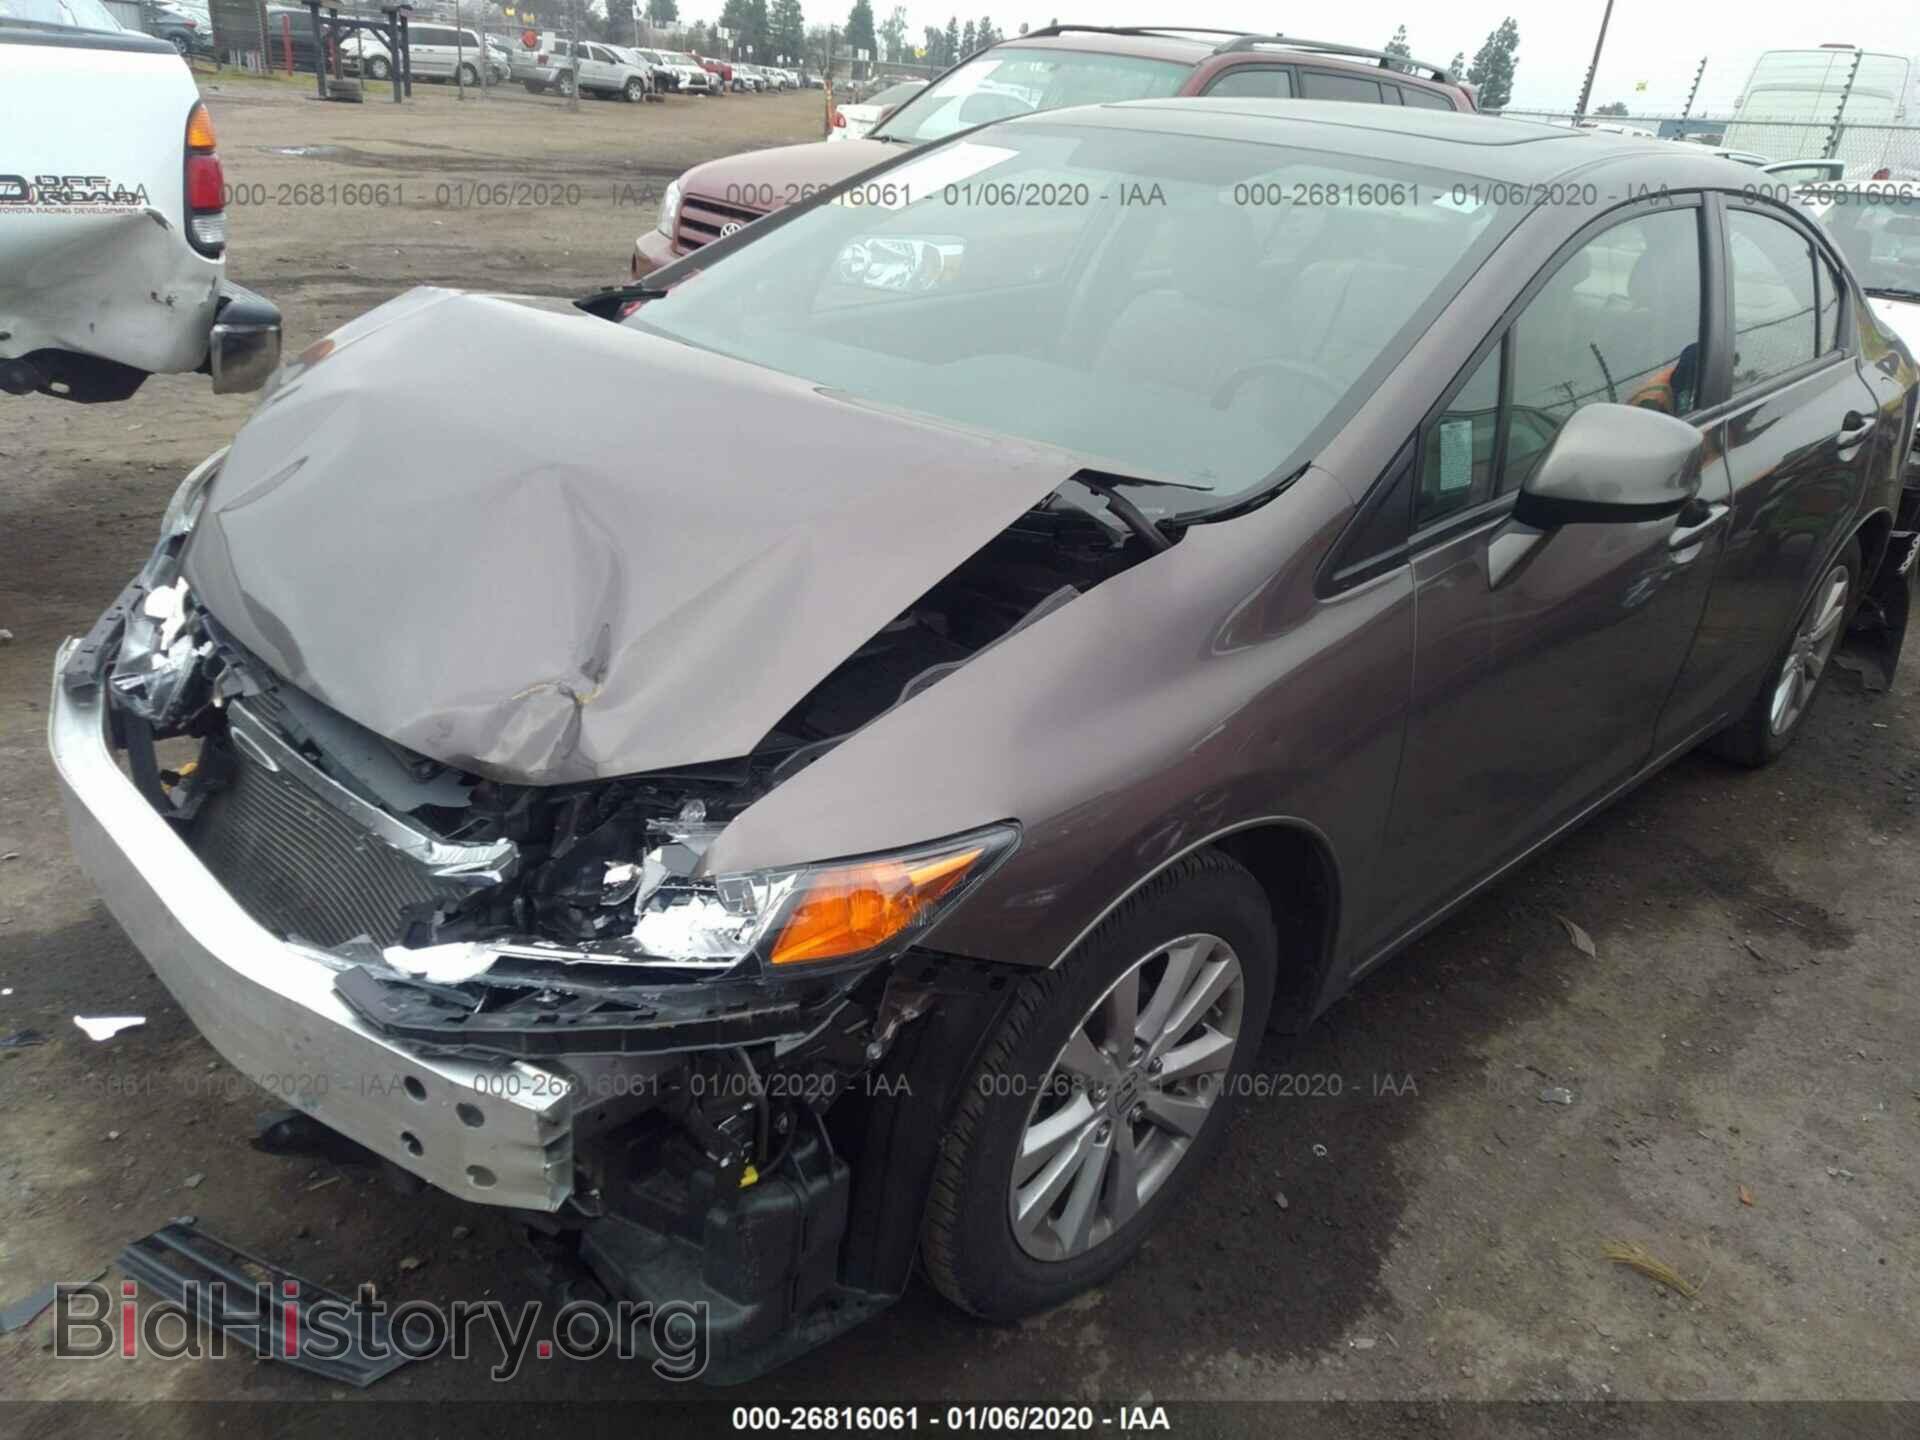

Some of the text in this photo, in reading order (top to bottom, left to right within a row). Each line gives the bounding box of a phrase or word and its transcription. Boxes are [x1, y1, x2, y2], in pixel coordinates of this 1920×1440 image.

[0, 207, 139, 215] TOYOTA RACING DEVELOPMENT
